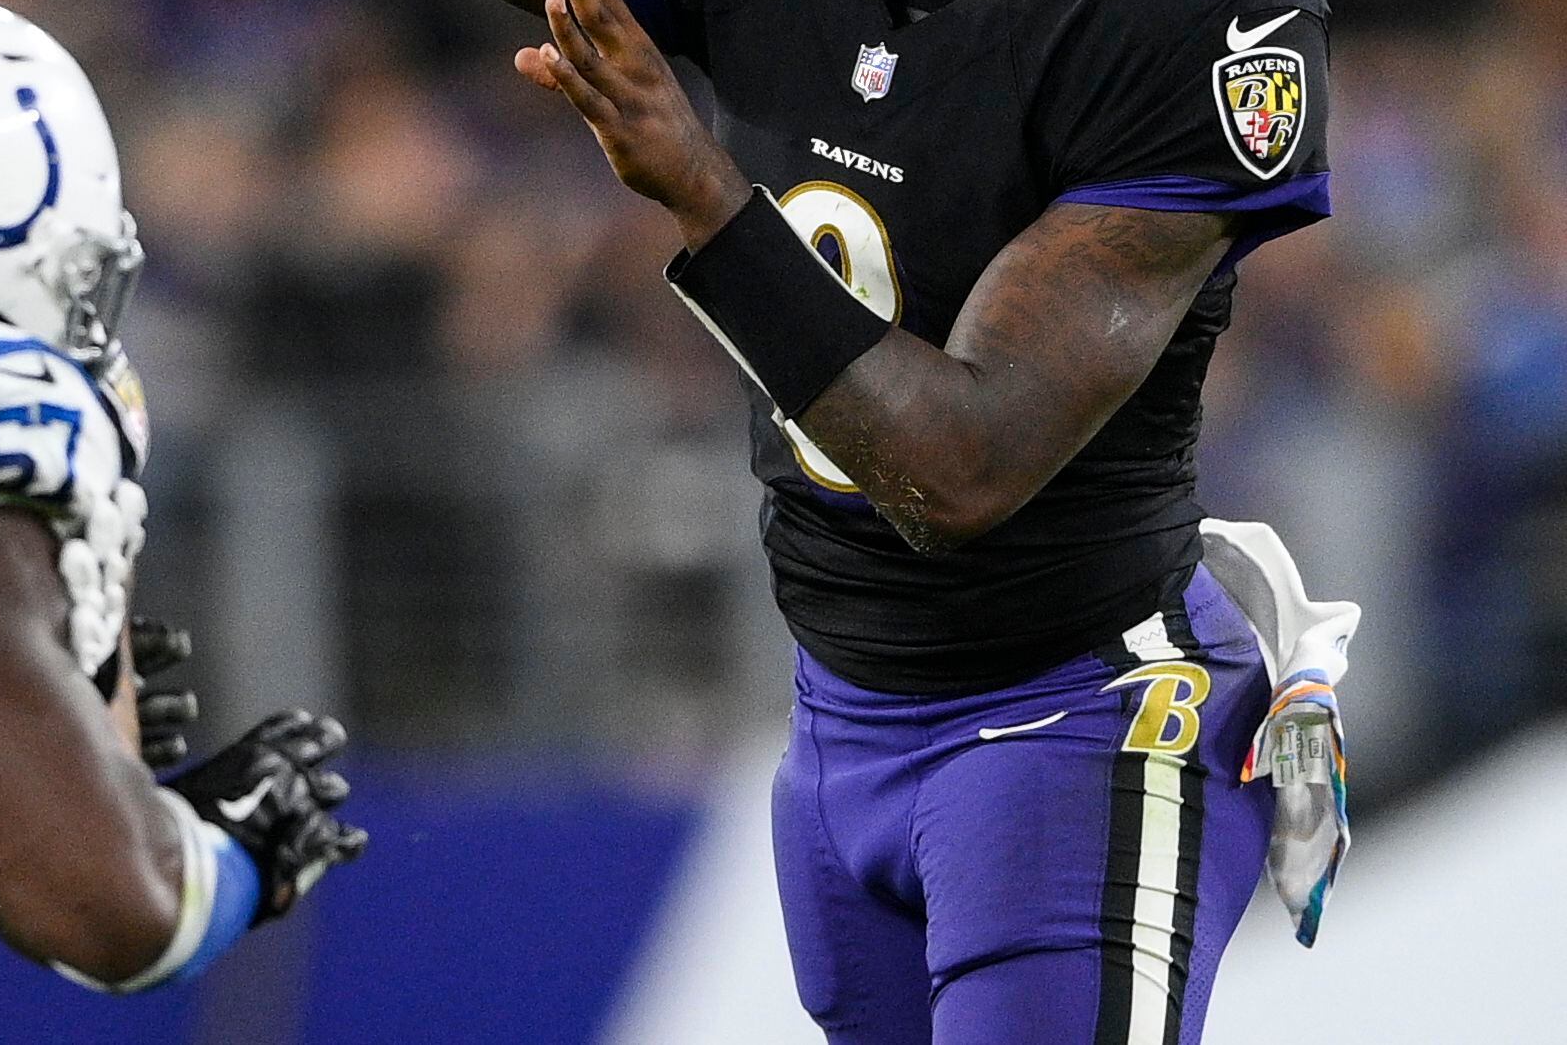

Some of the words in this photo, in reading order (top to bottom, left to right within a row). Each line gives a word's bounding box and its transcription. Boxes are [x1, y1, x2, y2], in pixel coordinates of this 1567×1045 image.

[1225, 59, 1296, 79] RAVENS
[1228, 76, 1270, 111] B
[811, 138, 904, 183] RAVENS
[1099, 660, 1211, 754] B
